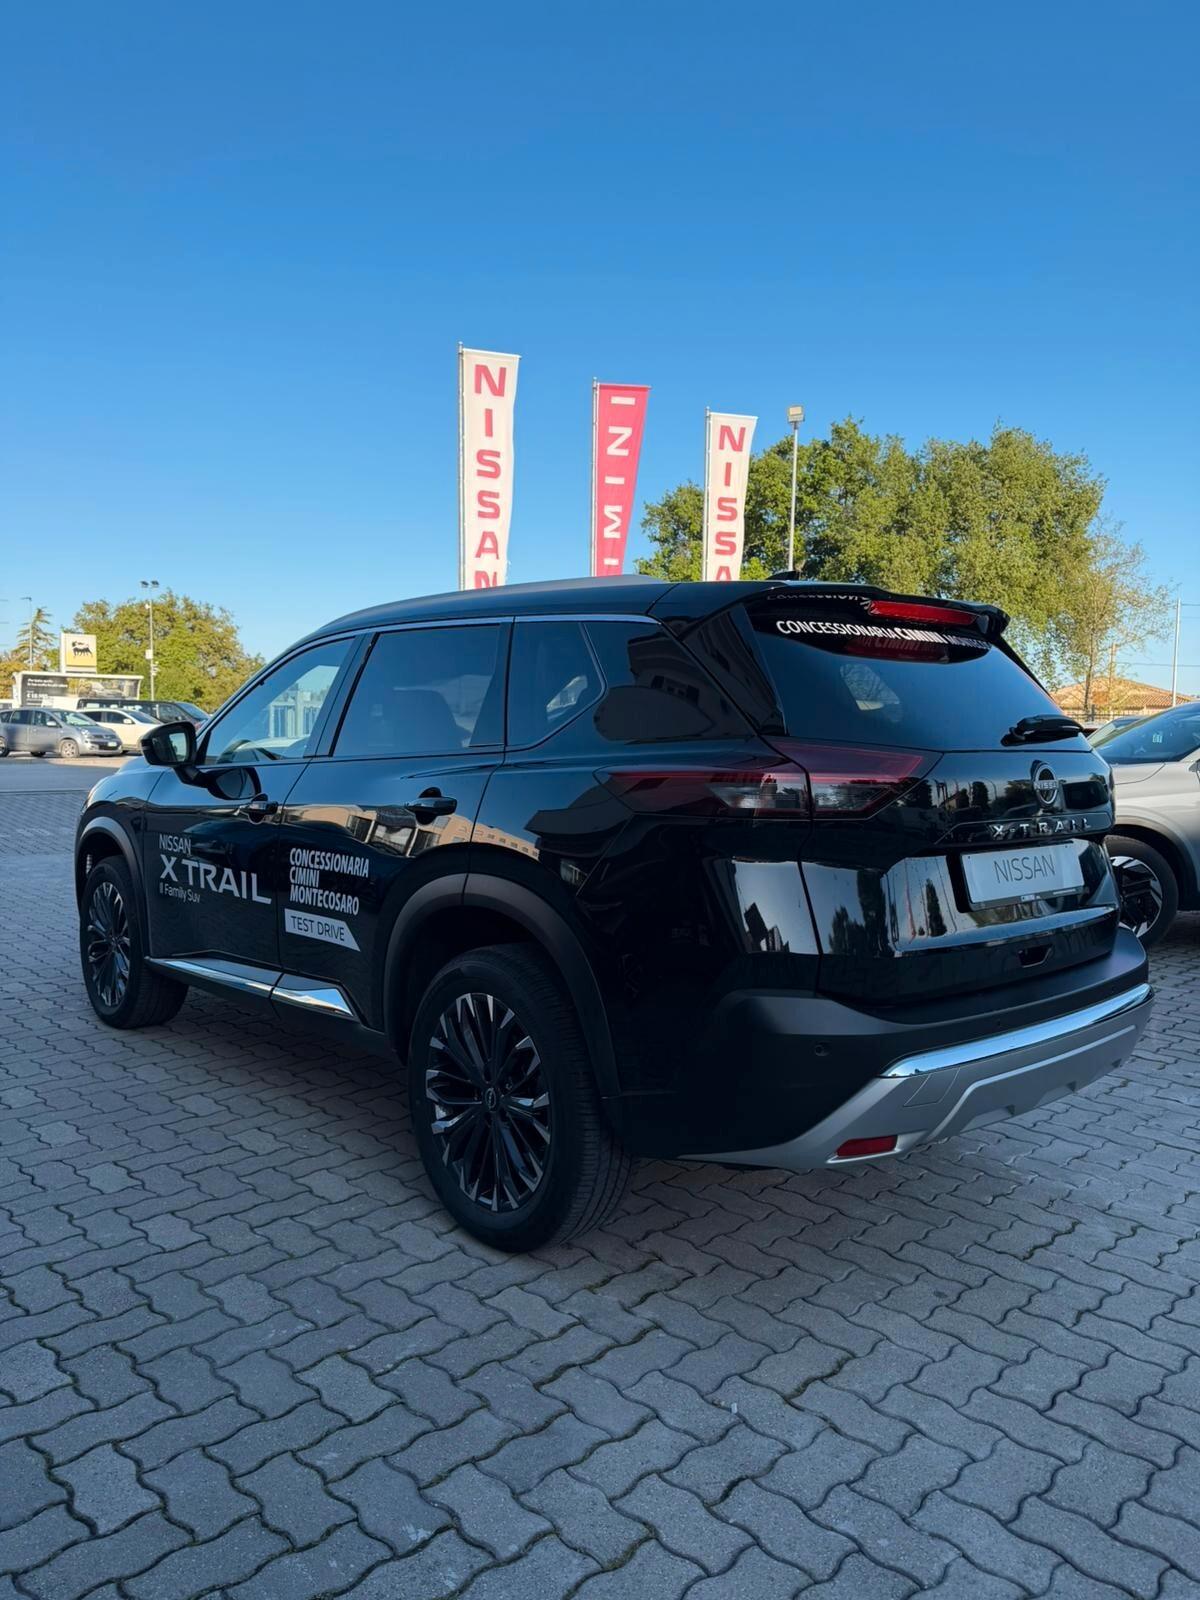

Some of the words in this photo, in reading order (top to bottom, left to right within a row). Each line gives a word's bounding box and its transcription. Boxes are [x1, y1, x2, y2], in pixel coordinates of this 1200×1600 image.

[715, 424, 746, 581] NISSA
[776, 620, 900, 639] CONCESSIONARIA
[992, 818, 1092, 838] X-TRAIL
[159, 833, 192, 856] NISSAN
[289, 847, 370, 878] CONCESSIONARIA
[993, 854, 1056, 884] NISSAN
[181, 859, 272, 905] TRAIL
[289, 866, 320, 888] CIMINI
[165, 883, 187, 902] Family
[290, 884, 360, 916] MONTECOSARO
[290, 915, 315, 934] TEST
[317, 921, 345, 942] DRIVE
